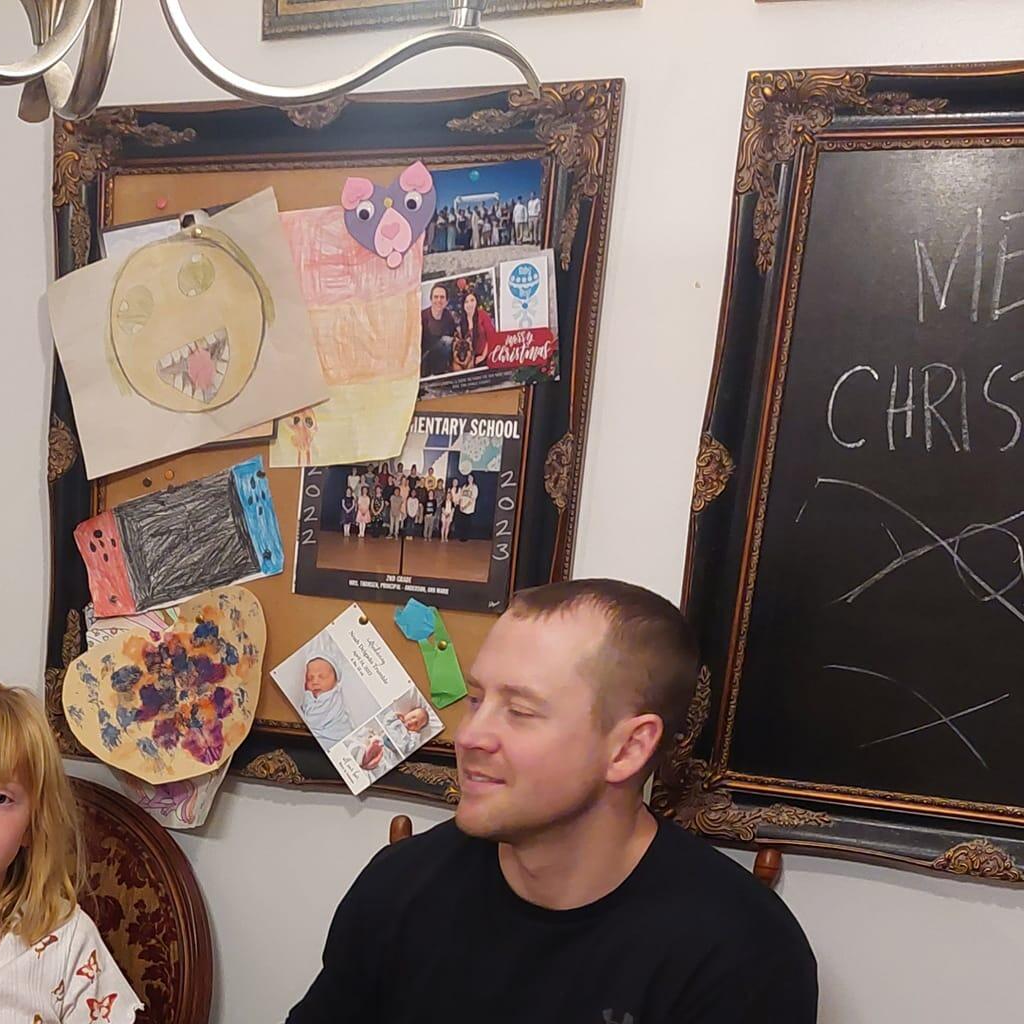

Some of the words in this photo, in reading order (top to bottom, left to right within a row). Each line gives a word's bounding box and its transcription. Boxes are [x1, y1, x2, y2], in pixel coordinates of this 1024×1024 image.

[491, 340, 552, 364] Christmas
[470, 418, 521, 439] SCHOOL
[827, 362, 1024, 452] CHRIS
[492, 470, 518, 561] 2023
